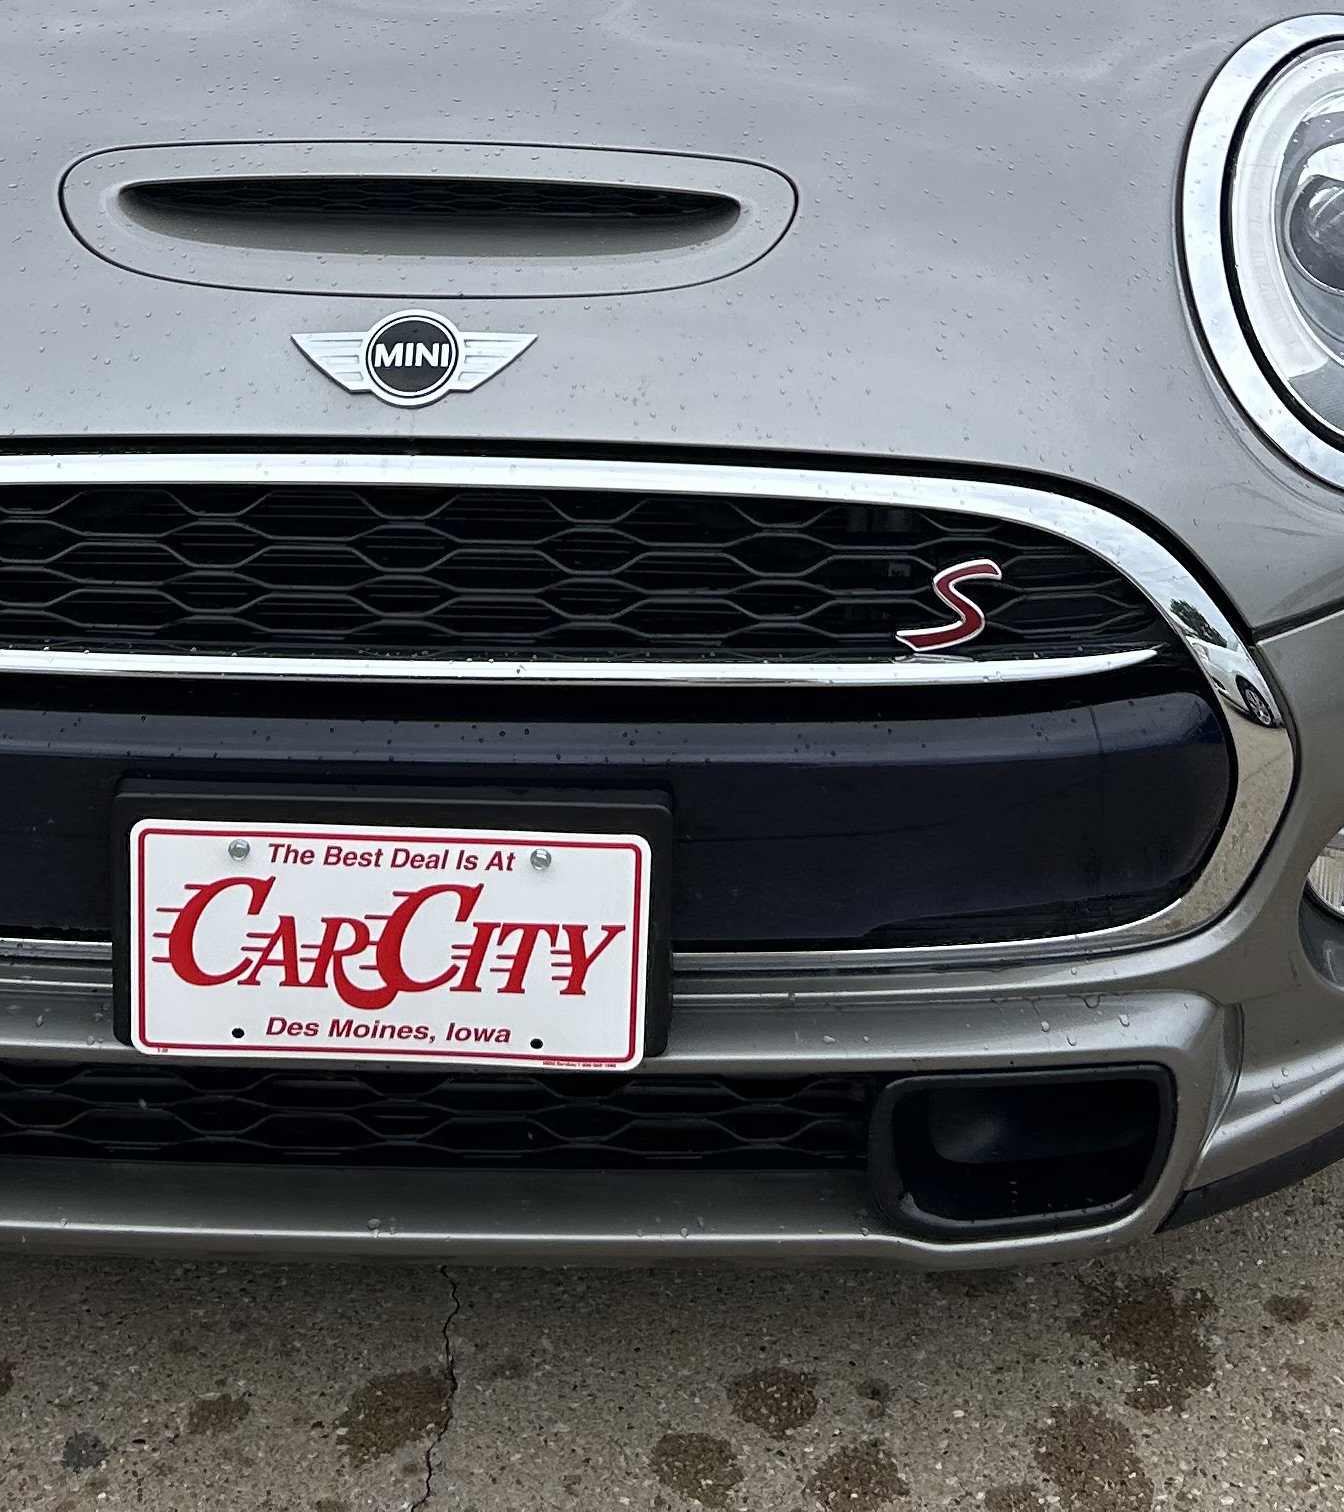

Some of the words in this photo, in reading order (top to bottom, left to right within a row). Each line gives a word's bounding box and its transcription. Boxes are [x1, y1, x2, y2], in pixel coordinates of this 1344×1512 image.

[374, 342, 450, 367] MINI
[895, 558, 1002, 652] S
[267, 843, 316, 866] The
[323, 845, 382, 868] Best
[390, 848, 450, 870] Deal
[456, 850, 478, 871] Is
[486, 850, 516, 872] At
[265, 1017, 319, 1038] Des
[328, 1018, 436, 1044] Moines,
[446, 1022, 511, 1044] Iowa
